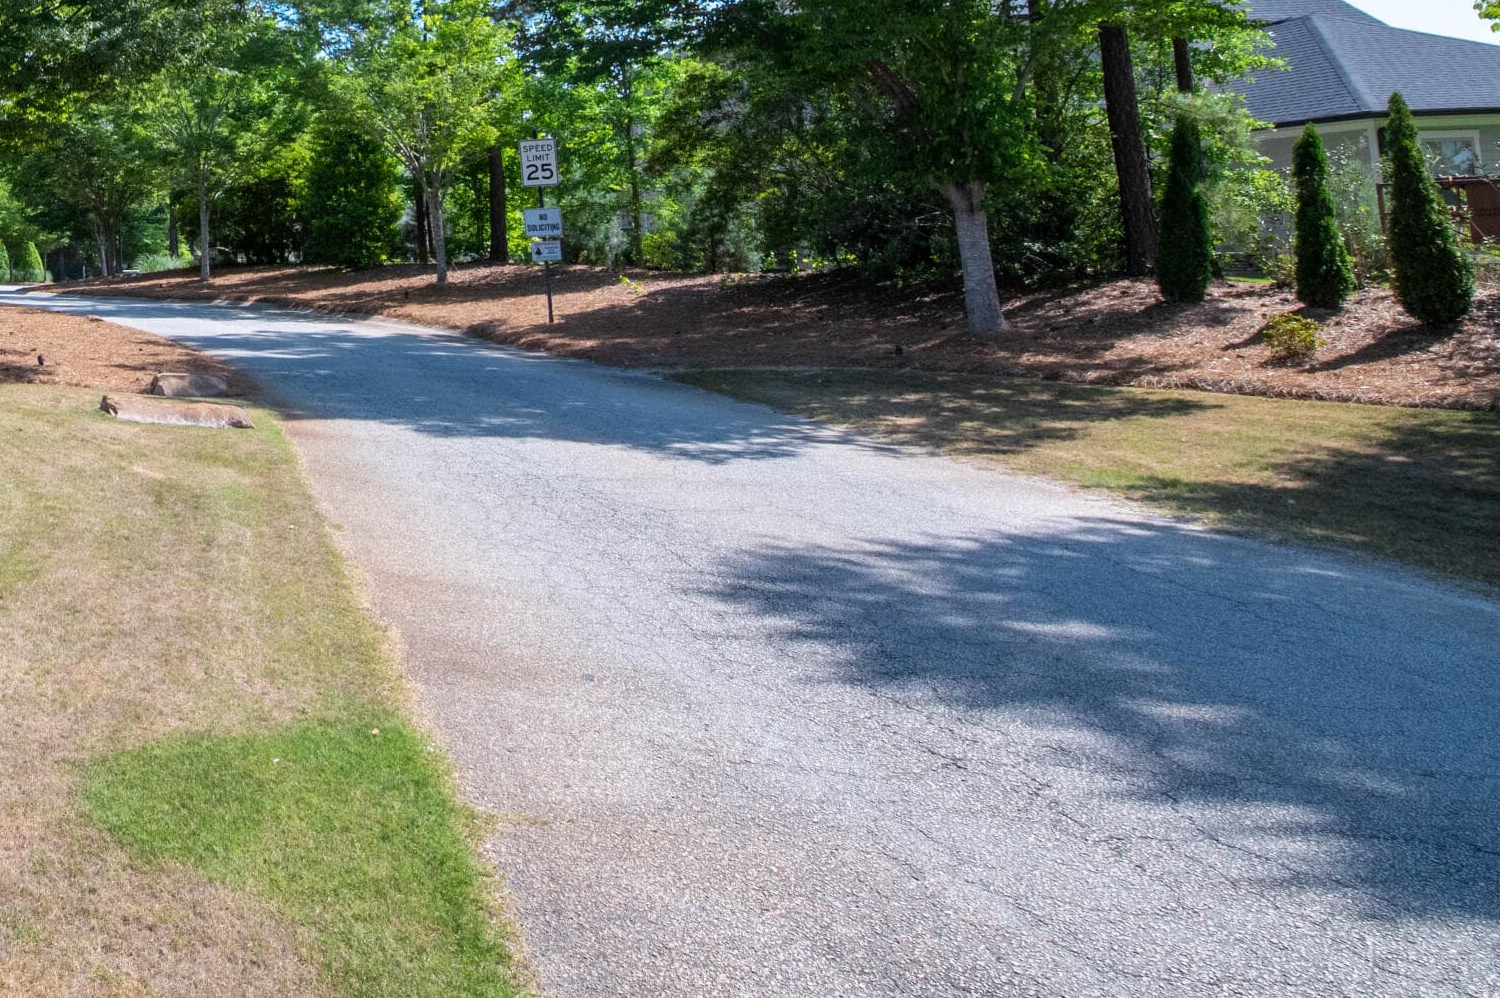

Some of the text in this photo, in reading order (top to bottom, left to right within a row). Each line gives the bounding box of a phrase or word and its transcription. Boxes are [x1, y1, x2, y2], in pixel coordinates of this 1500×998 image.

[523, 144, 553, 153] SPEED
[526, 153, 550, 162] LIMIT
[526, 163, 554, 180] 25
[539, 213, 548, 221] NO
[527, 223, 560, 232] SOLICITING
